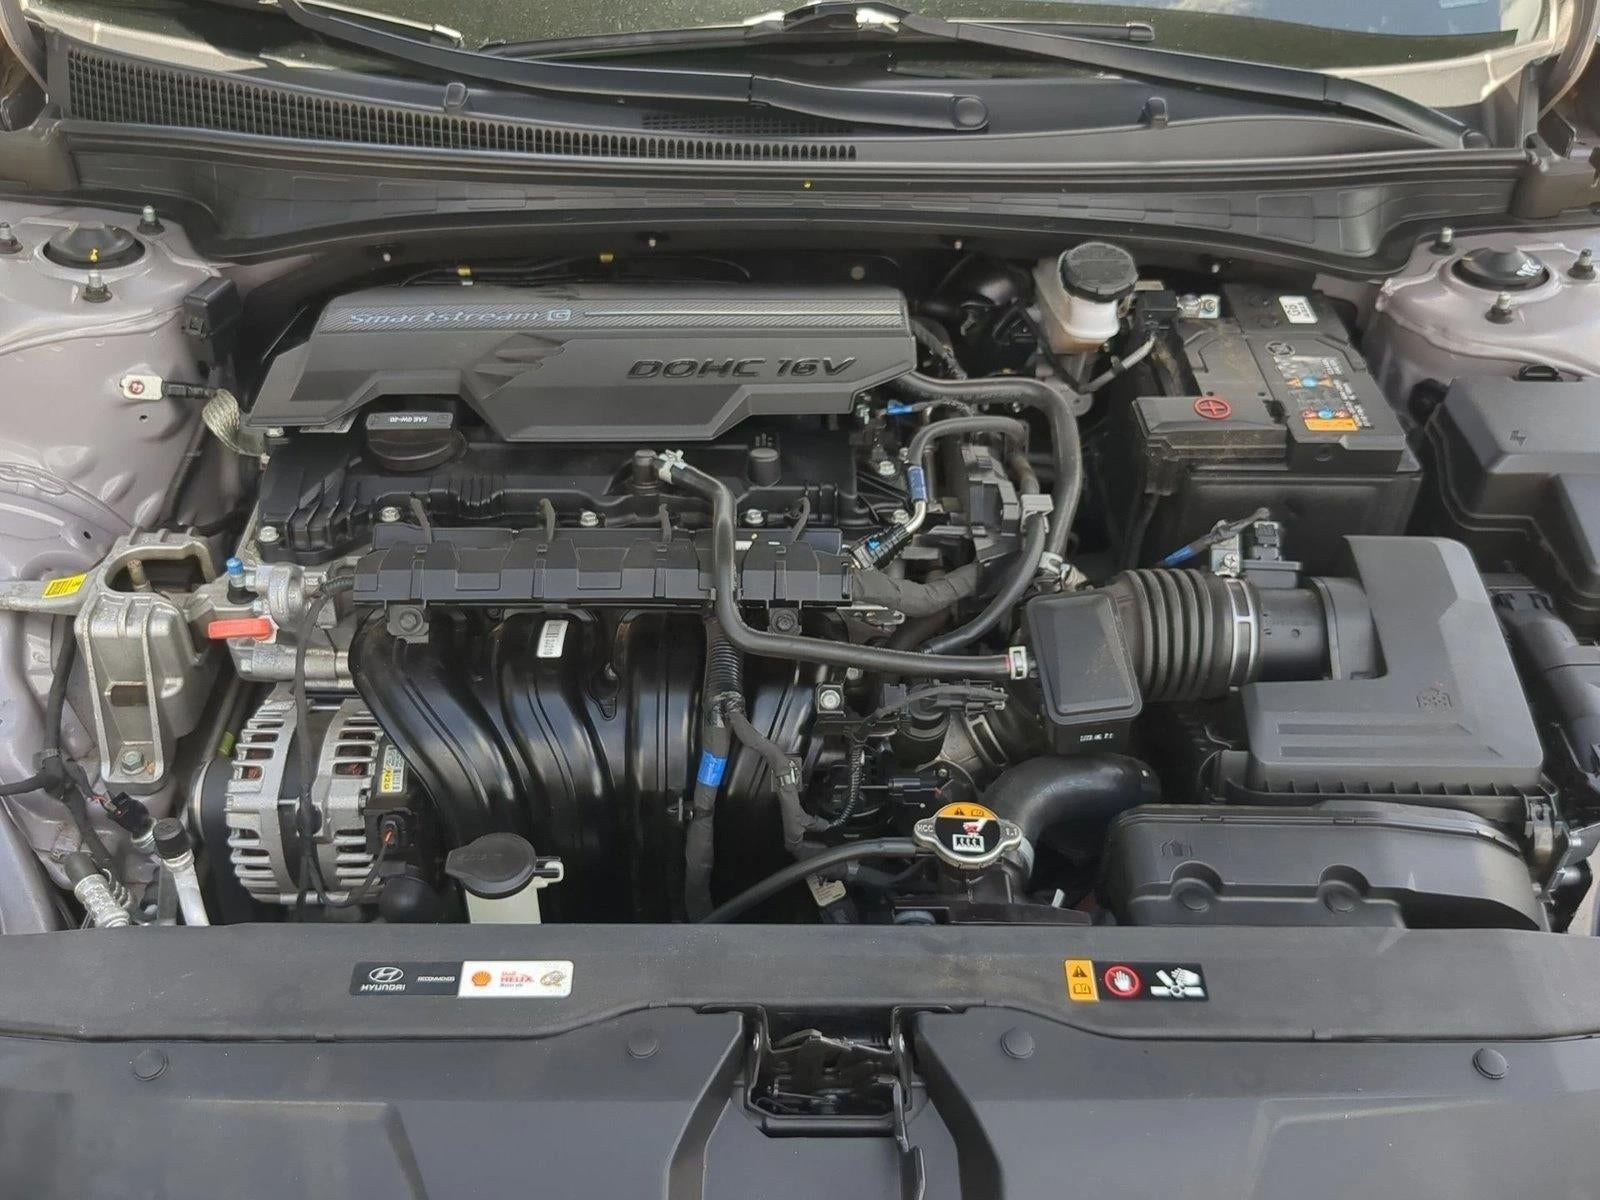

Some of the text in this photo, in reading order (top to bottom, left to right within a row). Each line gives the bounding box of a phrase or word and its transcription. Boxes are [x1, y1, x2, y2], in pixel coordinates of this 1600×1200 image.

[348, 310, 540, 325] Smartstream
[626, 357, 857, 379] DOHC 16V
[916, 823, 935, 833] HCC
[1005, 826, 1019, 836] 1.1
[359, 983, 406, 992] HYUNDAI
